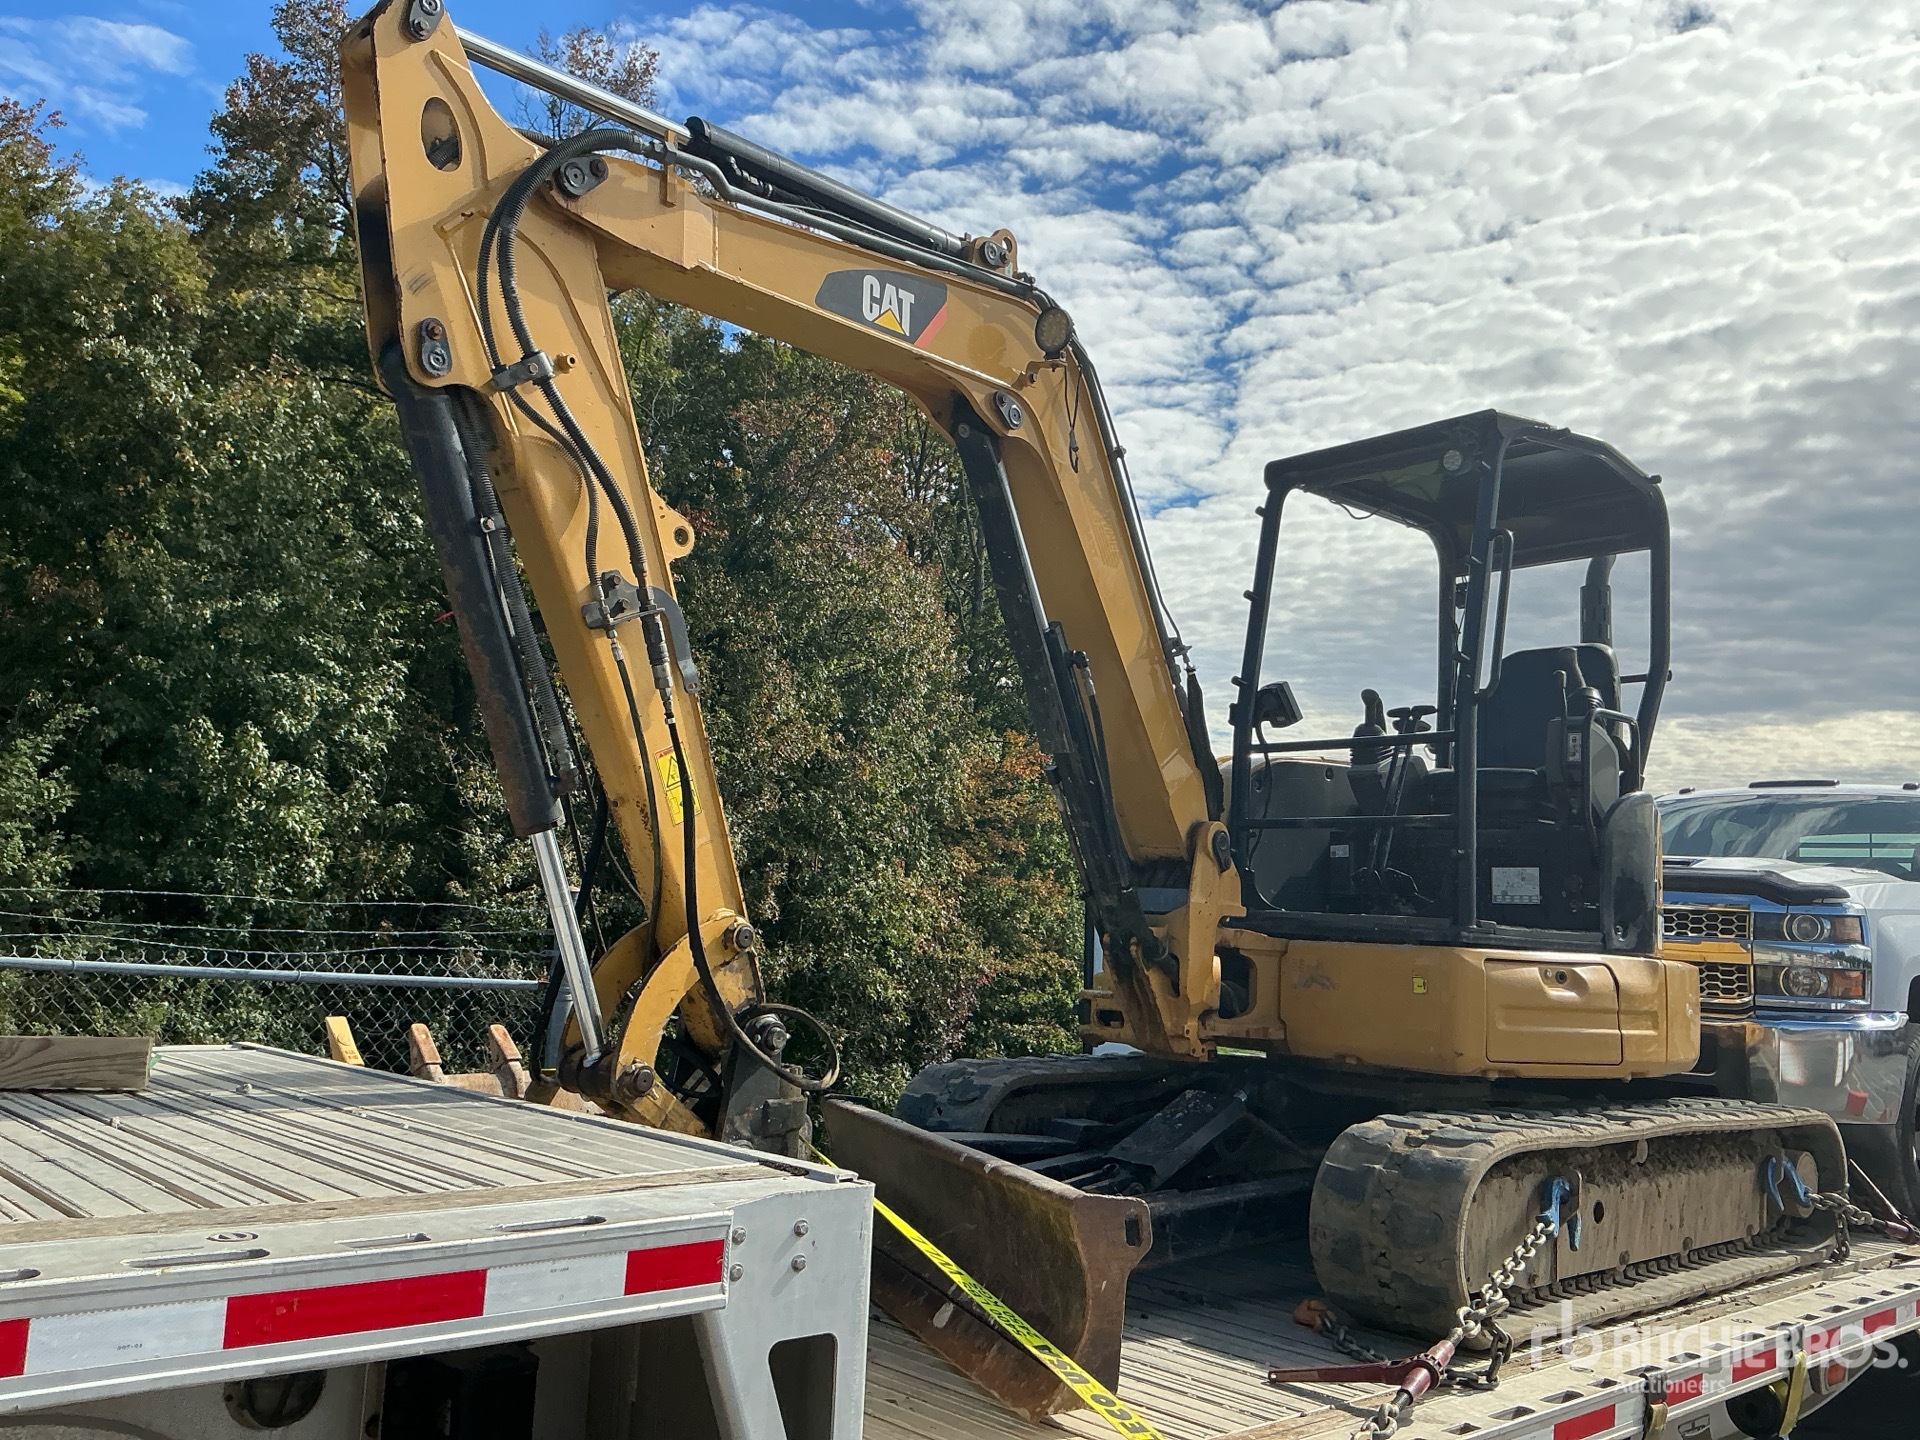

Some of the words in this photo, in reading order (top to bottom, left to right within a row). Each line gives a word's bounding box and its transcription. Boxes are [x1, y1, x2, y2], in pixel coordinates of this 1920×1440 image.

[862, 274, 915, 337] CAT
[968, 1281, 1005, 1310] KGS
[989, 1308, 1028, 1337] 5400
[1033, 1344, 1091, 1385] USA
